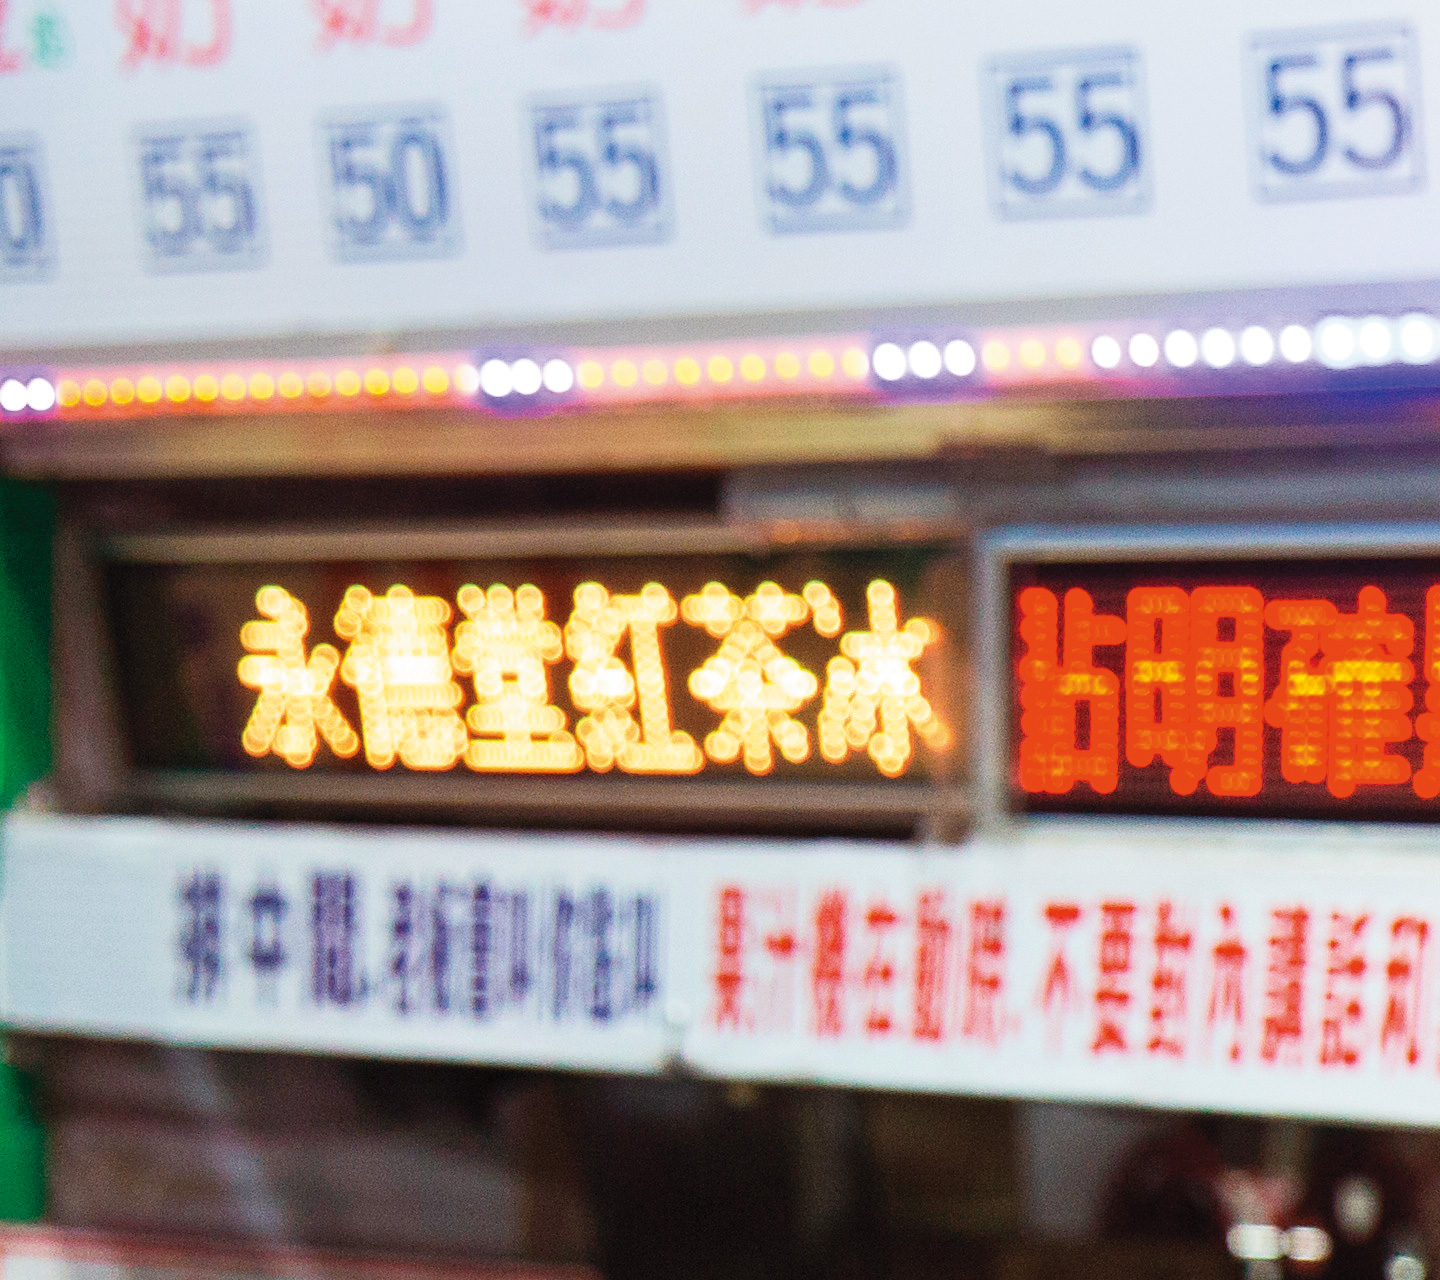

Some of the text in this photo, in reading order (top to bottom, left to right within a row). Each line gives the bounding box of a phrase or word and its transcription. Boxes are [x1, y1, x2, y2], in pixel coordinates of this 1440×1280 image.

[529, 104, 662, 232] 55
[760, 80, 899, 207] 55
[1002, 69, 1140, 198] 55
[1265, 48, 1410, 175] 55
[139, 142, 258, 257] 55
[326, 122, 452, 244] 50
[238, 579, 954, 777] 永德堂紅茶冰
